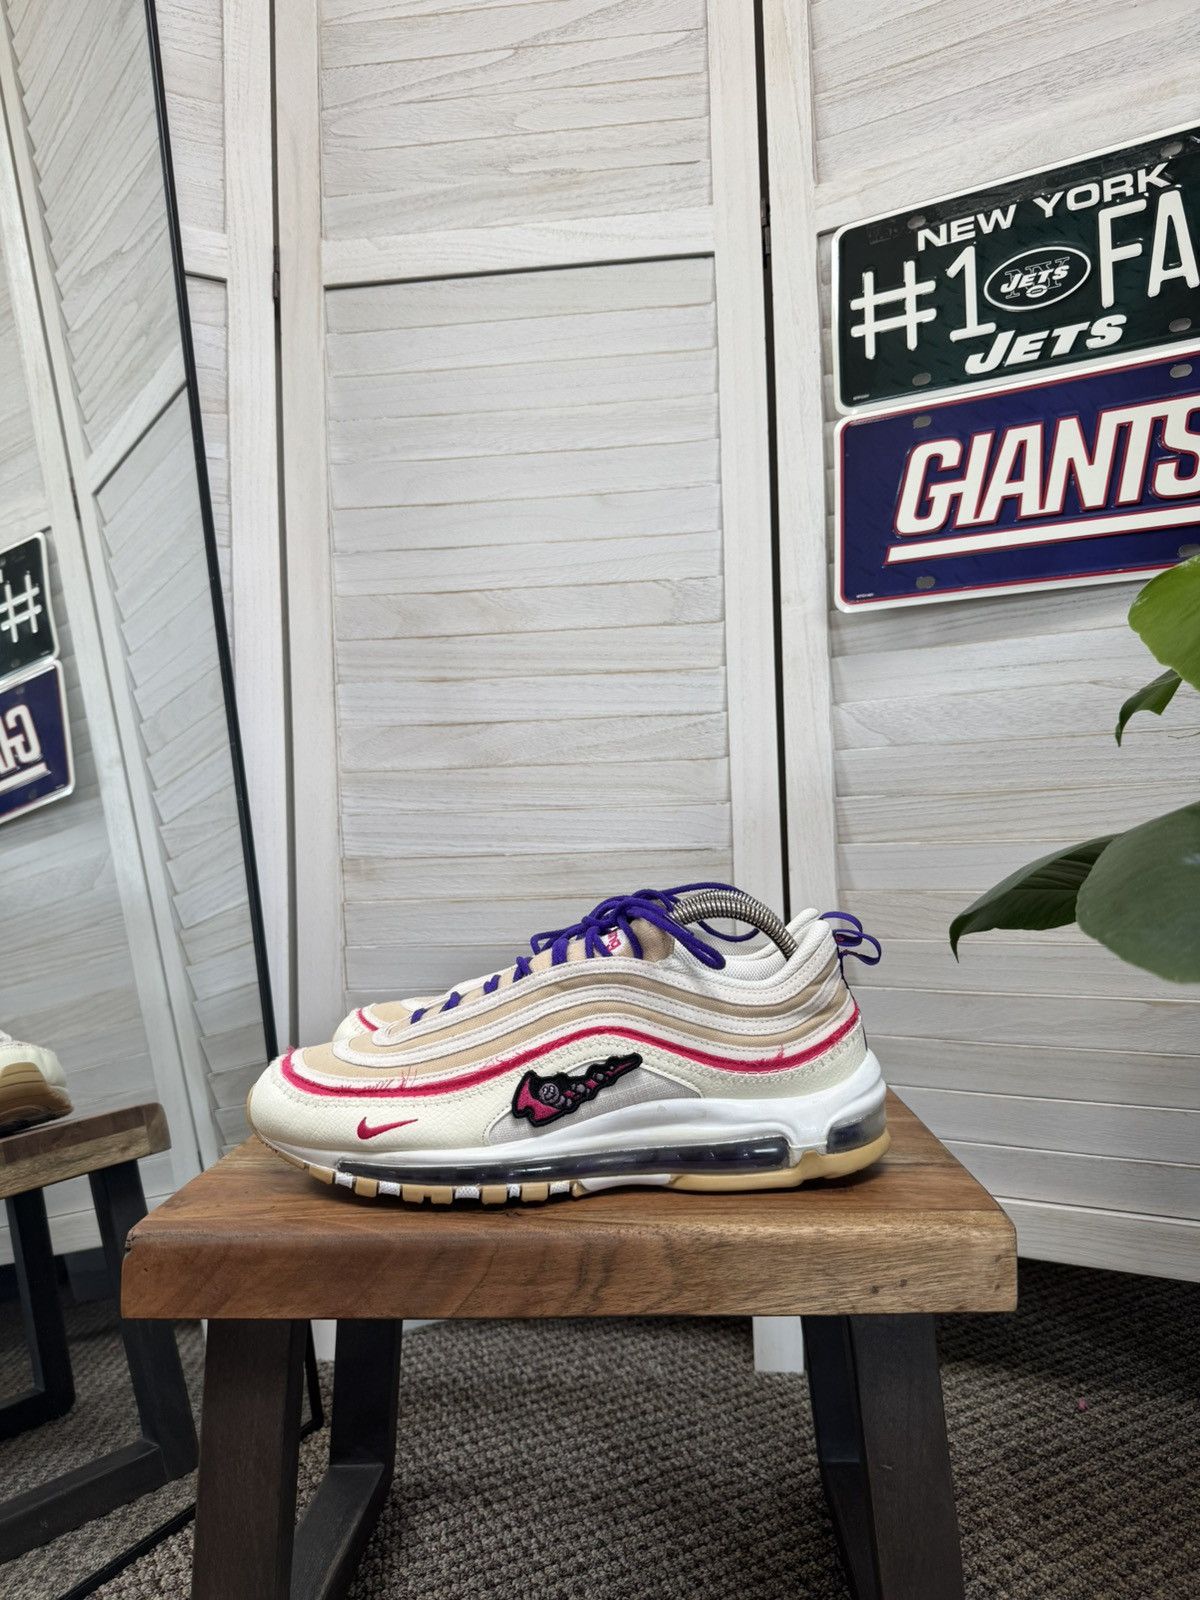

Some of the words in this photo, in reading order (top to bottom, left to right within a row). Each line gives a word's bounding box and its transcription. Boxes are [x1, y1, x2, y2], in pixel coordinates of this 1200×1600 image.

[917, 205, 1017, 252] NEW
[1032, 162, 1172, 218] YORK
[850, 245, 998, 360] #1
[1000, 265, 1070, 293] JETS
[964, 314, 1127, 375] JETS
[893, 394, 1200, 538] GIANTS
